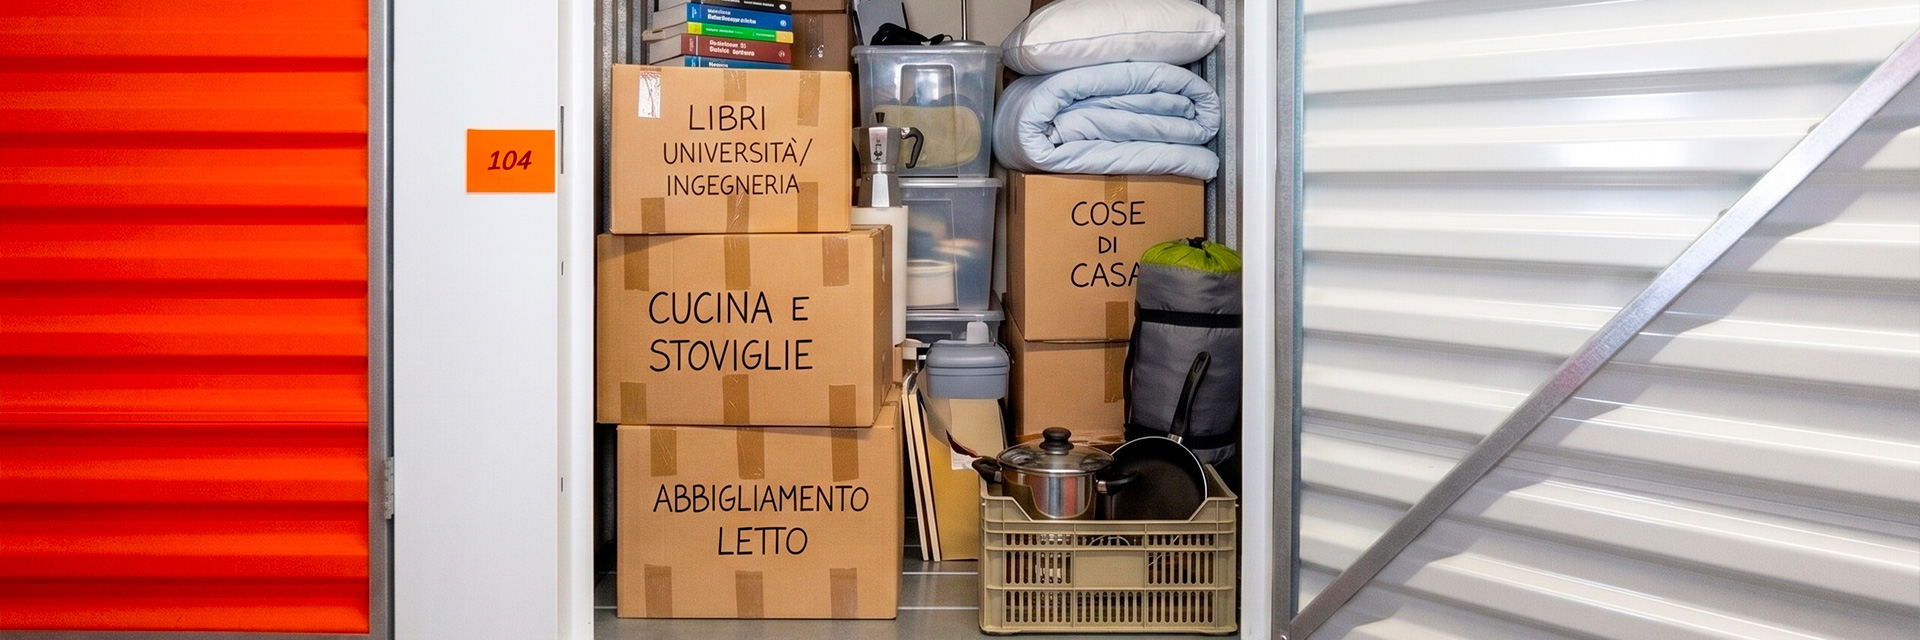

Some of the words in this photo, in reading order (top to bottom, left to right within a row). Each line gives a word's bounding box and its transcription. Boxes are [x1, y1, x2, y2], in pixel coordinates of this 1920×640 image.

[689, 104, 766, 131] LIBRI
[487, 150, 532, 171] 104
[663, 137, 813, 167] UNIVERSITÀ/
[667, 174, 800, 196] INGEGNERIA
[1071, 201, 1146, 226] COSE
[1098, 236, 1117, 254] DI
[649, 291, 773, 324] CUCINA
[792, 296, 810, 321] E
[650, 339, 813, 372] STOVIGLIE
[652, 483, 869, 513] ABBIGLIAMENTO
[718, 526, 808, 556] LETTO
